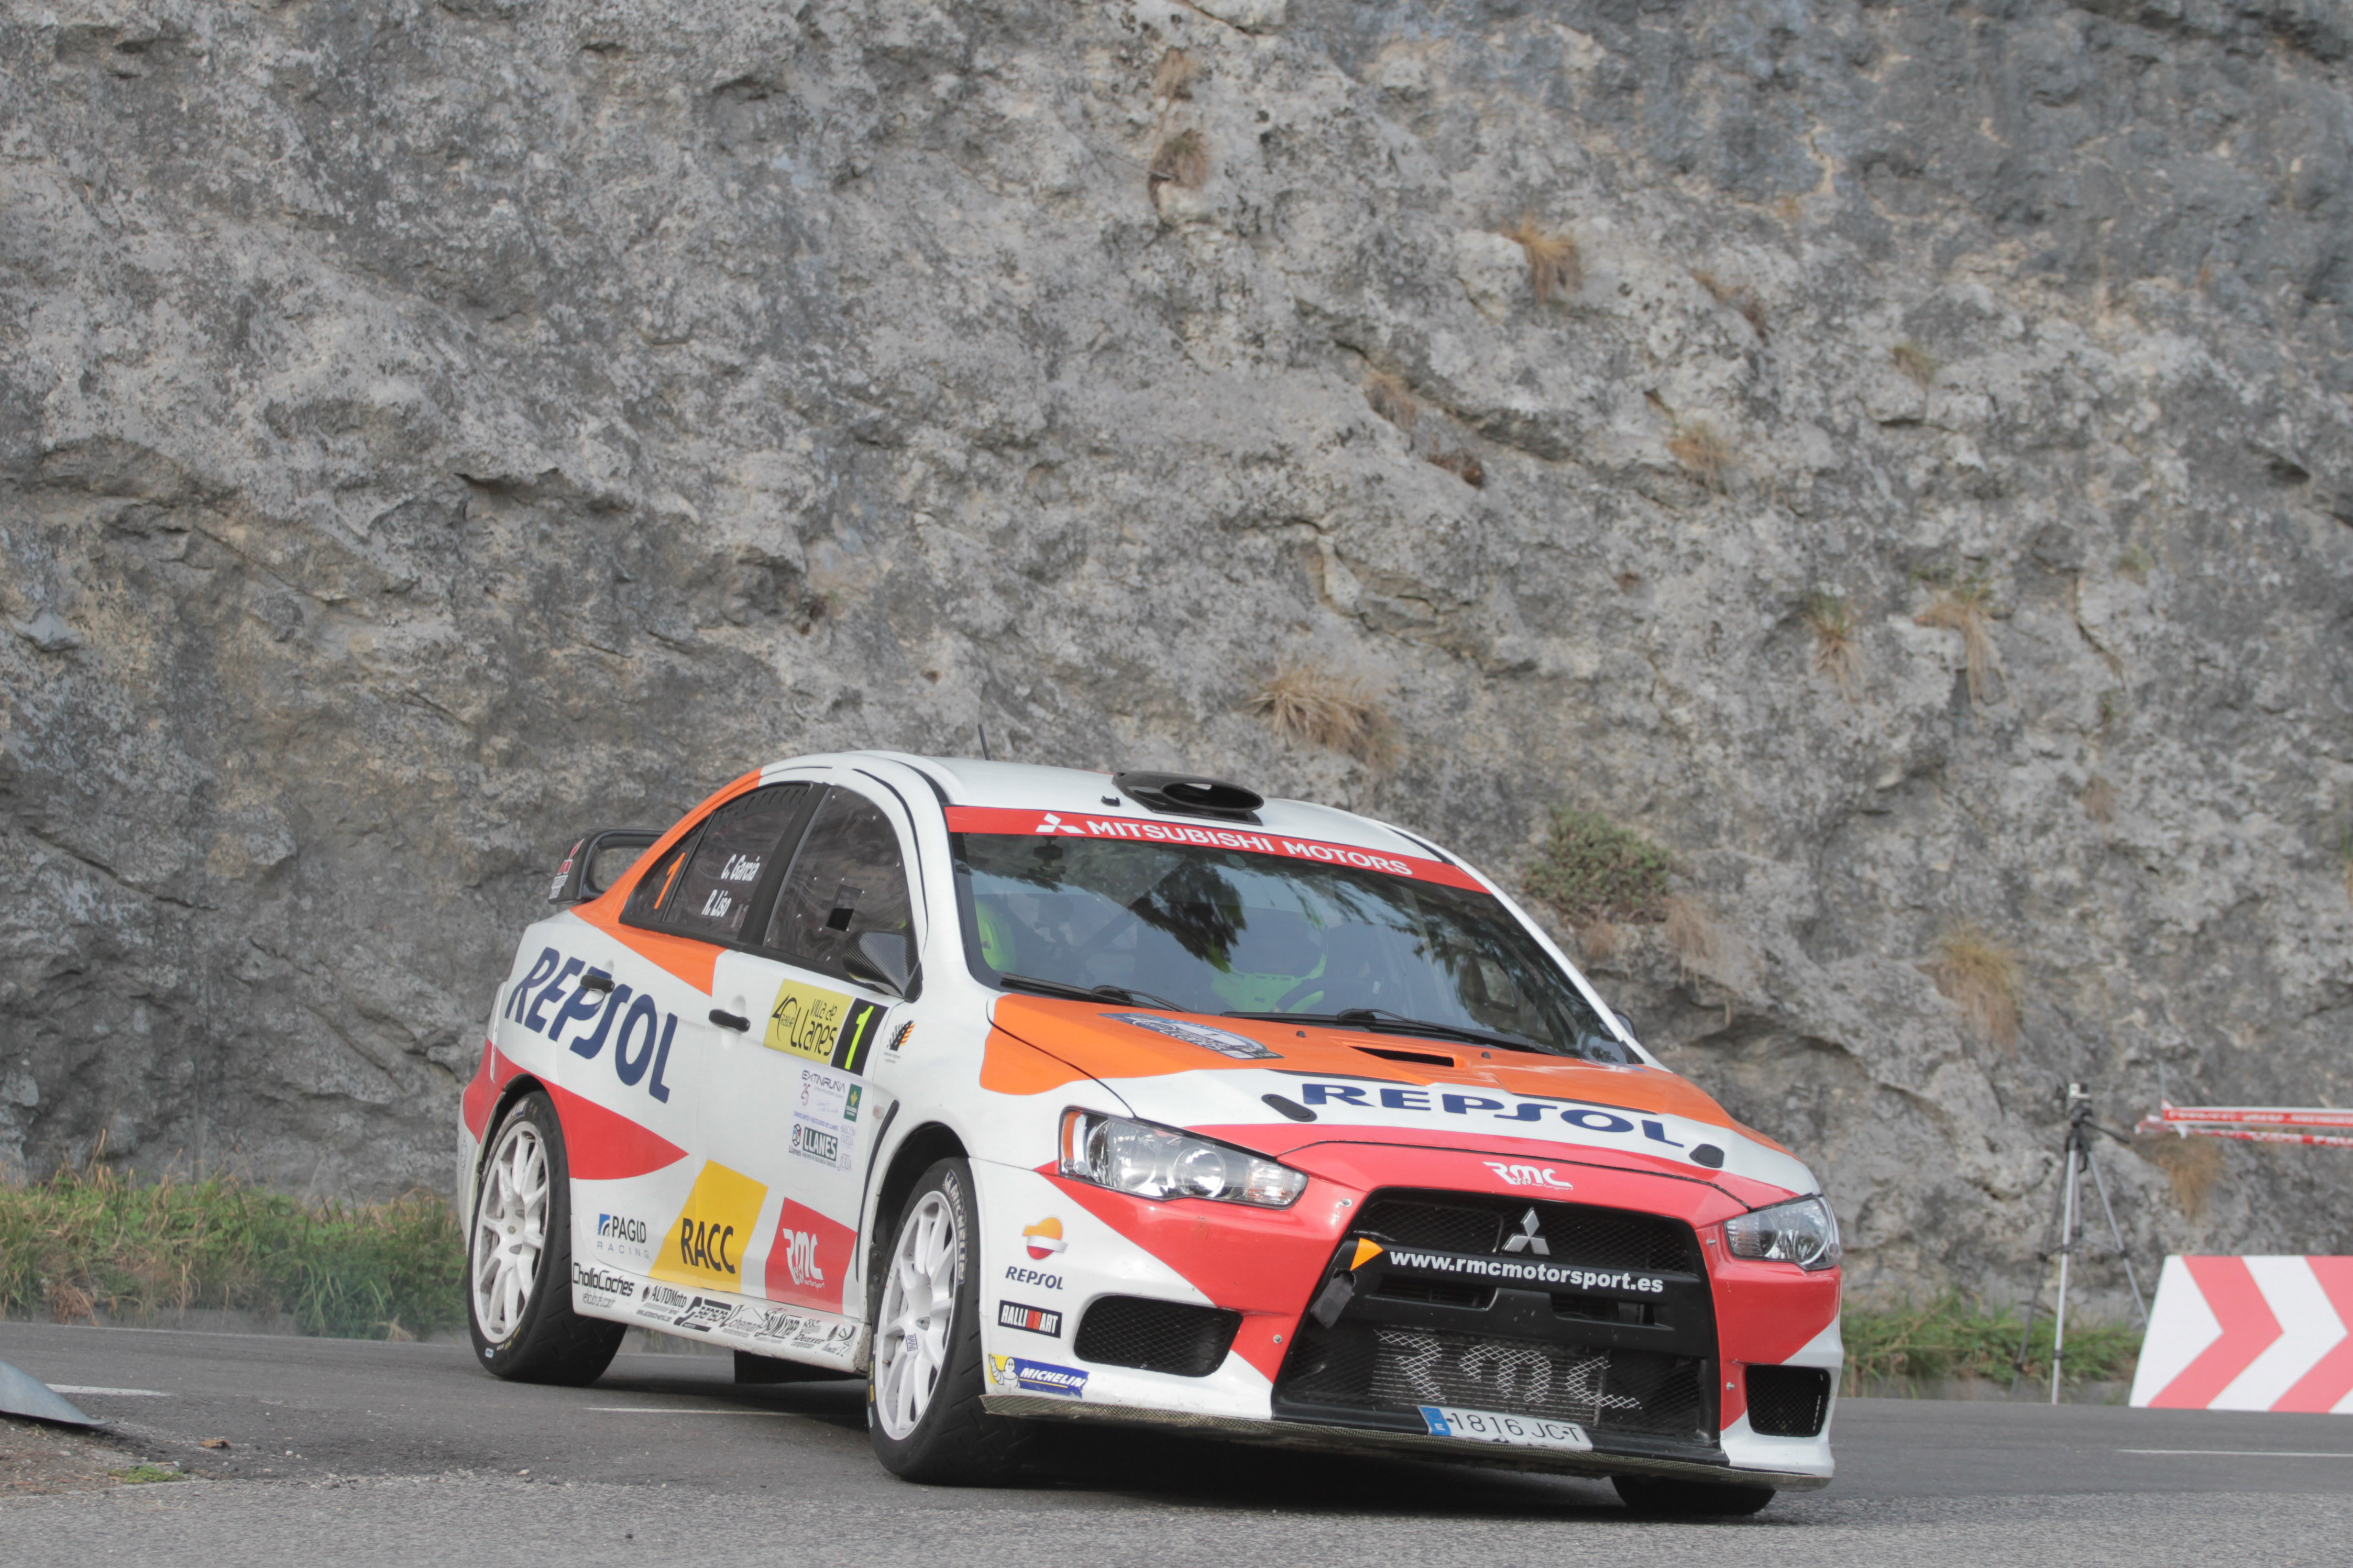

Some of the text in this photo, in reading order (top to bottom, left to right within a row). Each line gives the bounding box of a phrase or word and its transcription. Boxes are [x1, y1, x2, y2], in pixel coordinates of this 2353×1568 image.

[1087, 820, 1413, 876] MITSUBISHI MOTORS
[653, 853, 686, 909] 1
[721, 854, 736, 879] C.
[701, 889, 732, 918] R. Liso
[504, 947, 678, 1104] REPSOL
[826, 1003, 838, 1021] de
[790, 1007, 838, 1056] Llanes
[844, 1005, 874, 1070] 1
[1302, 1084, 1684, 1148] REPSOL
[804, 1129, 837, 1160] LLANES
[612, 1216, 646, 1244] PAGID
[681, 1217, 736, 1274] RACC
[597, 1241, 649, 1259] RACING
[573, 1262, 635, 1297] CholloCoches
[1005, 1266, 1063, 1289] REPSOL
[1390, 1251, 1664, 1294] www.rmcmotorsport.es
[1020, 1367, 1087, 1387] MICHELIN
[1451, 1412, 1579, 1441] 1816 JCT
